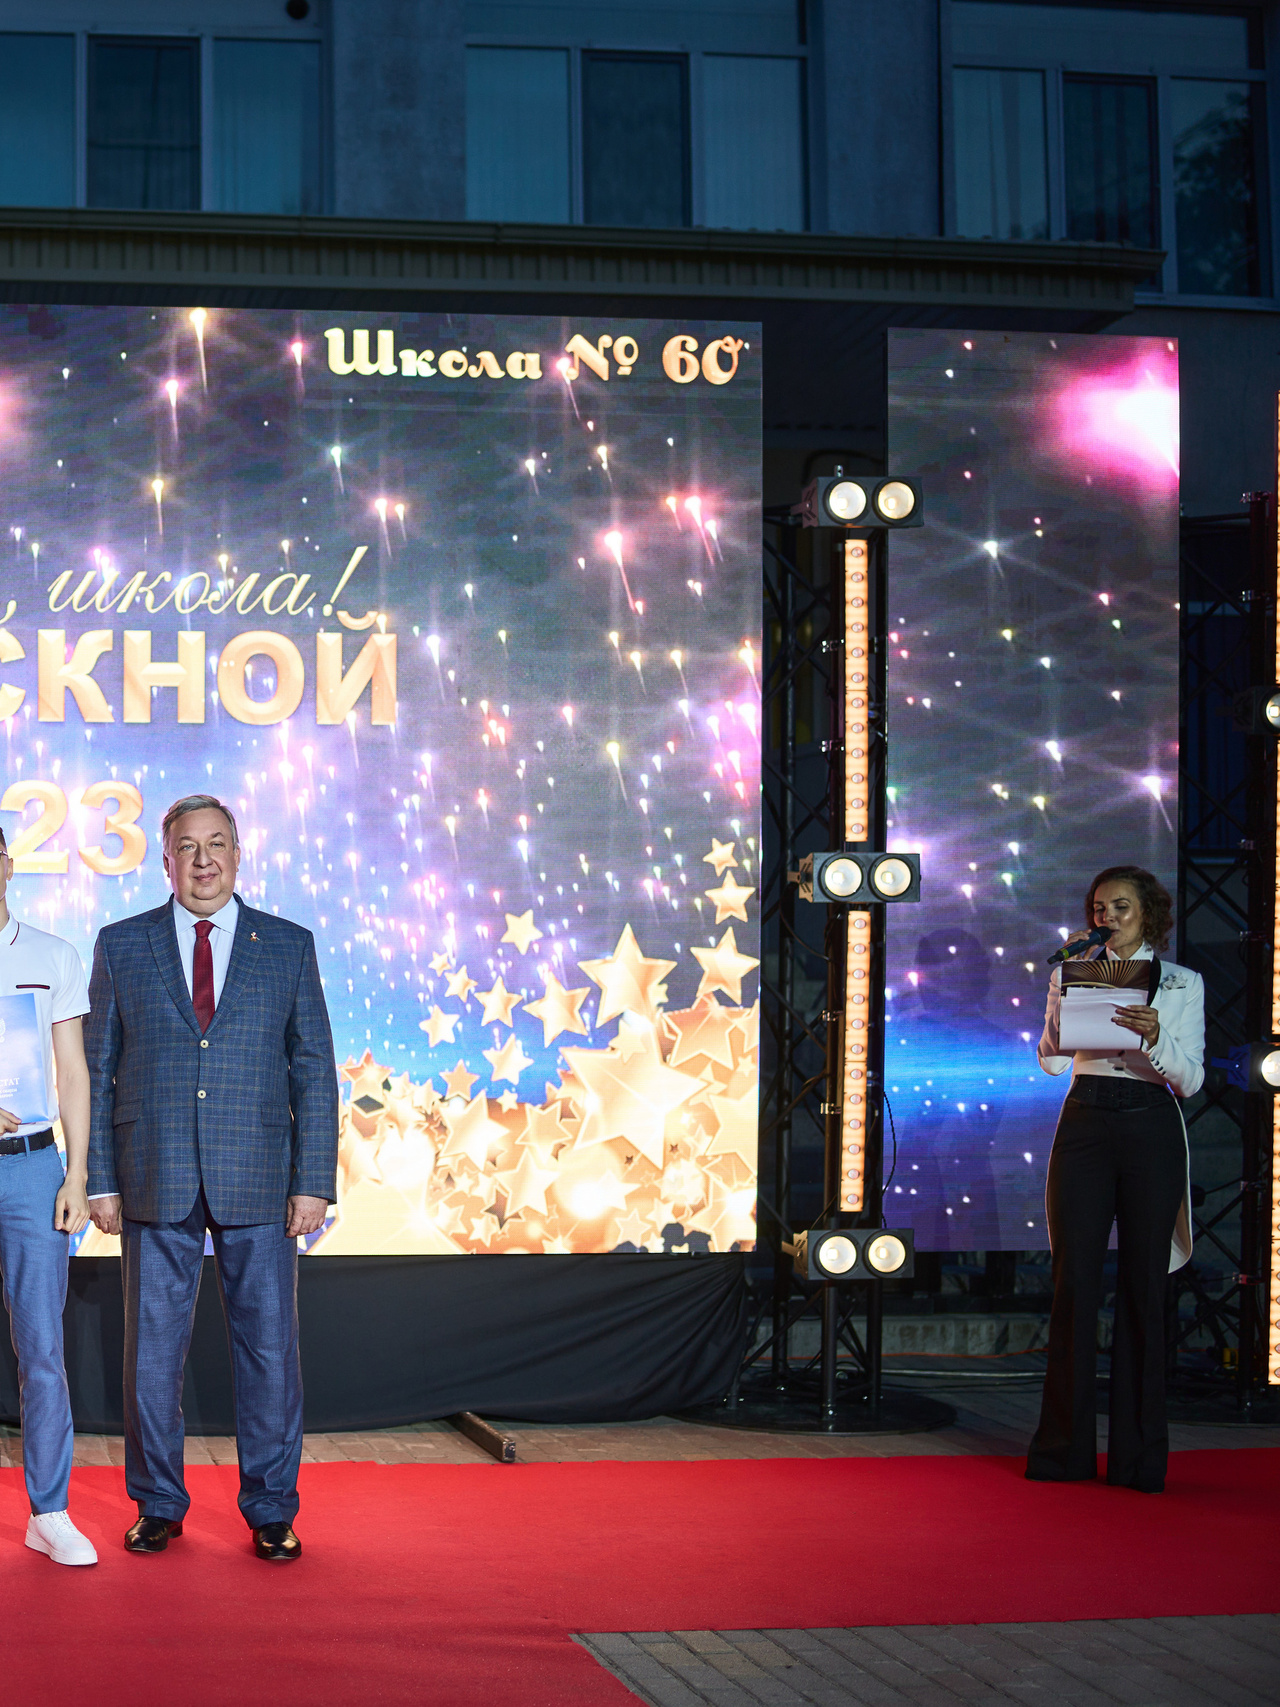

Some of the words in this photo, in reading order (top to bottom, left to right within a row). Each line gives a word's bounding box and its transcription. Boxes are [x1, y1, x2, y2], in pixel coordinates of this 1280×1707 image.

[324, 327, 543, 379] Школа
[661, 334, 744, 385] 60
[47, 545, 369, 617] школа!
